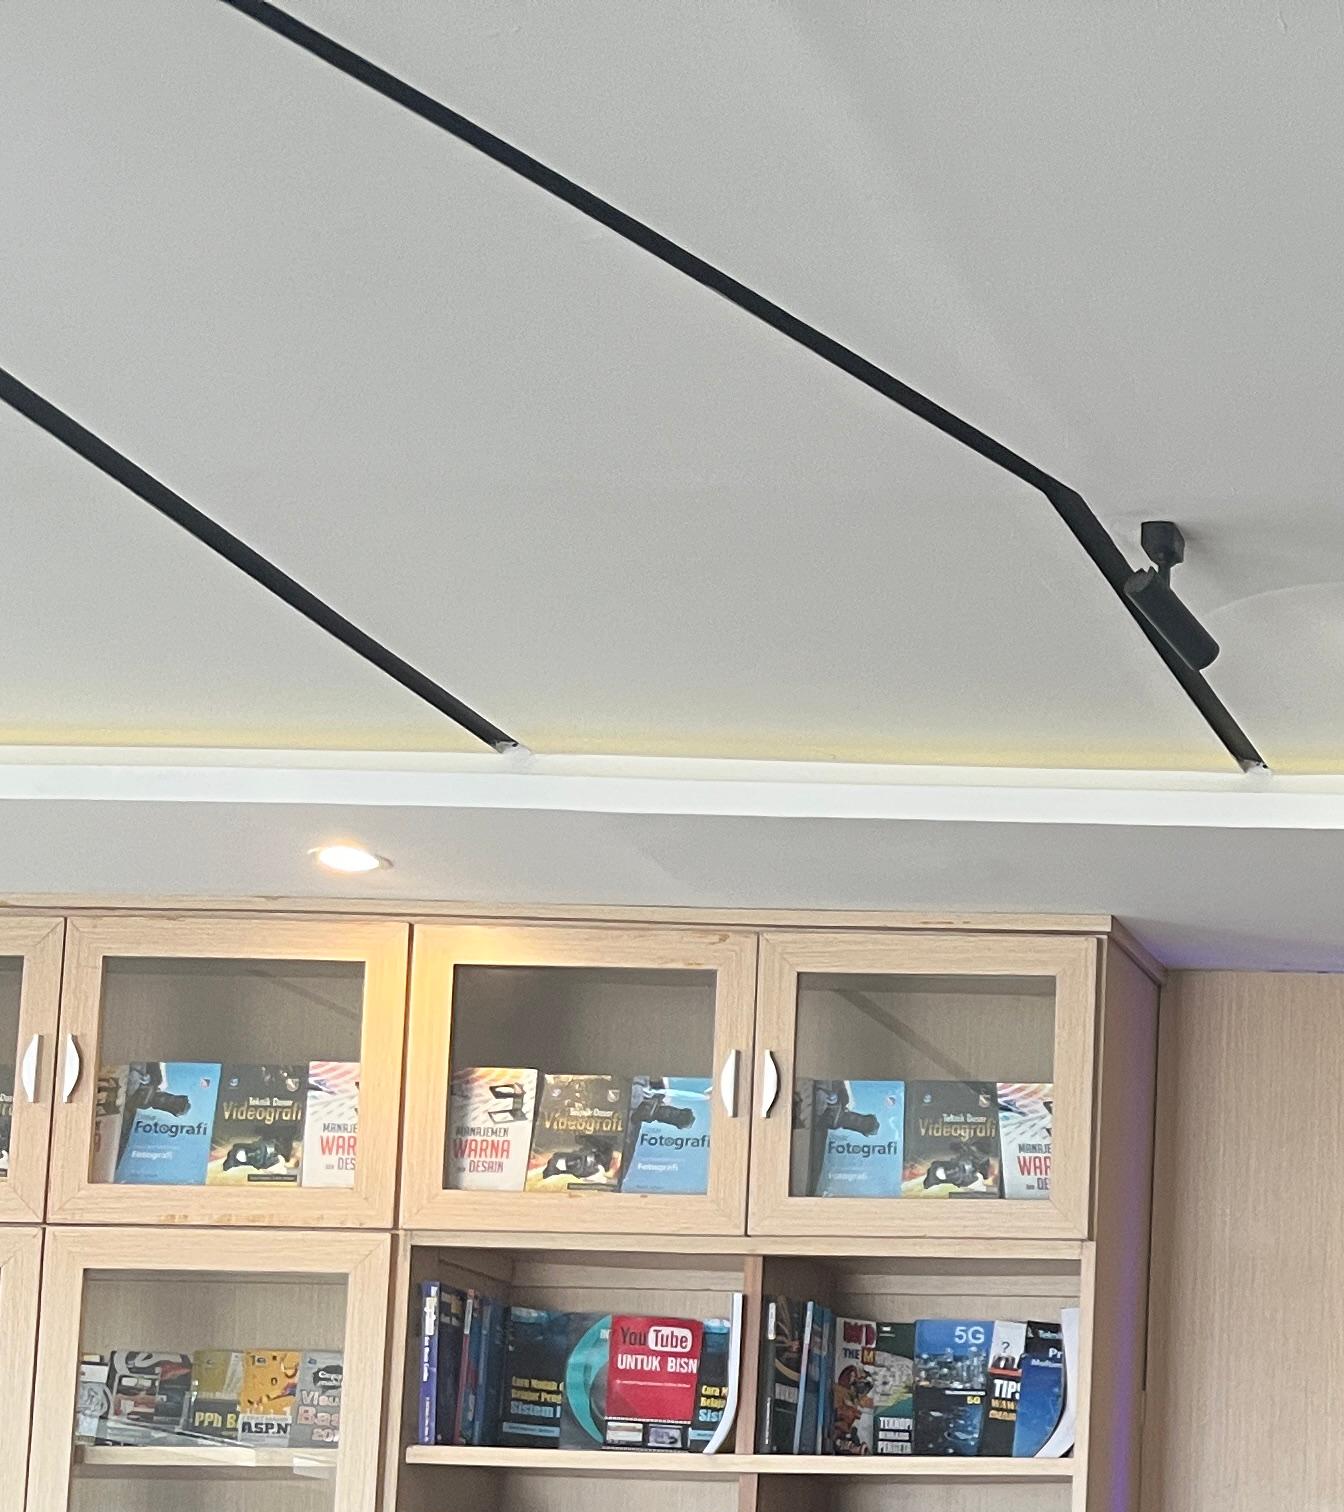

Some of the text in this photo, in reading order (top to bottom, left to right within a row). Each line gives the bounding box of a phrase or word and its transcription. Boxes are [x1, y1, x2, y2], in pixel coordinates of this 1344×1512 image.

[223, 1103, 302, 1125] Videografi
[544, 1112, 623, 1134] Videografi
[134, 1120, 208, 1137] Fotografi
[919, 1118, 996, 1141] Videografi
[454, 1139, 511, 1159] WARNA
[640, 1133, 711, 1151] Fotografi
[828, 1140, 898, 1158] Fotografi
[620, 1326, 689, 1350] YouTube
[954, 1326, 985, 1344] 5G
[617, 1353, 661, 1371] UNTUK
[666, 1356, 698, 1374] BISN
